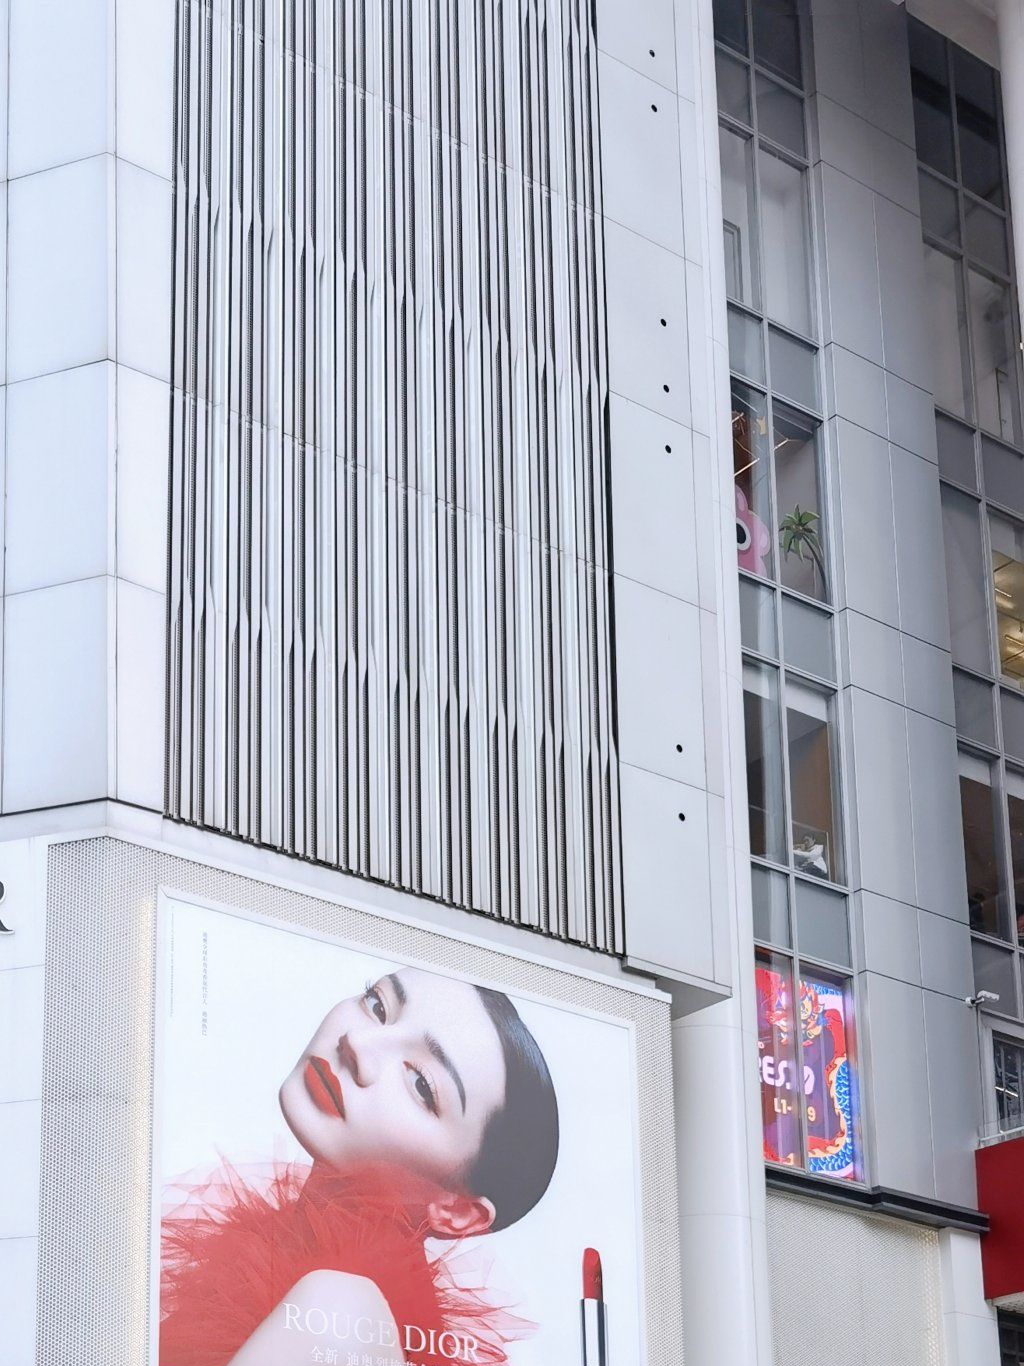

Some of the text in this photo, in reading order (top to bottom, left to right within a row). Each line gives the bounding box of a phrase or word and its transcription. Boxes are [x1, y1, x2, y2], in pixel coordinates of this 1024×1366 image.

[283, 1303, 480, 1363] ROUGE DIOR
[311, 1345, 338, 1365] 全新
